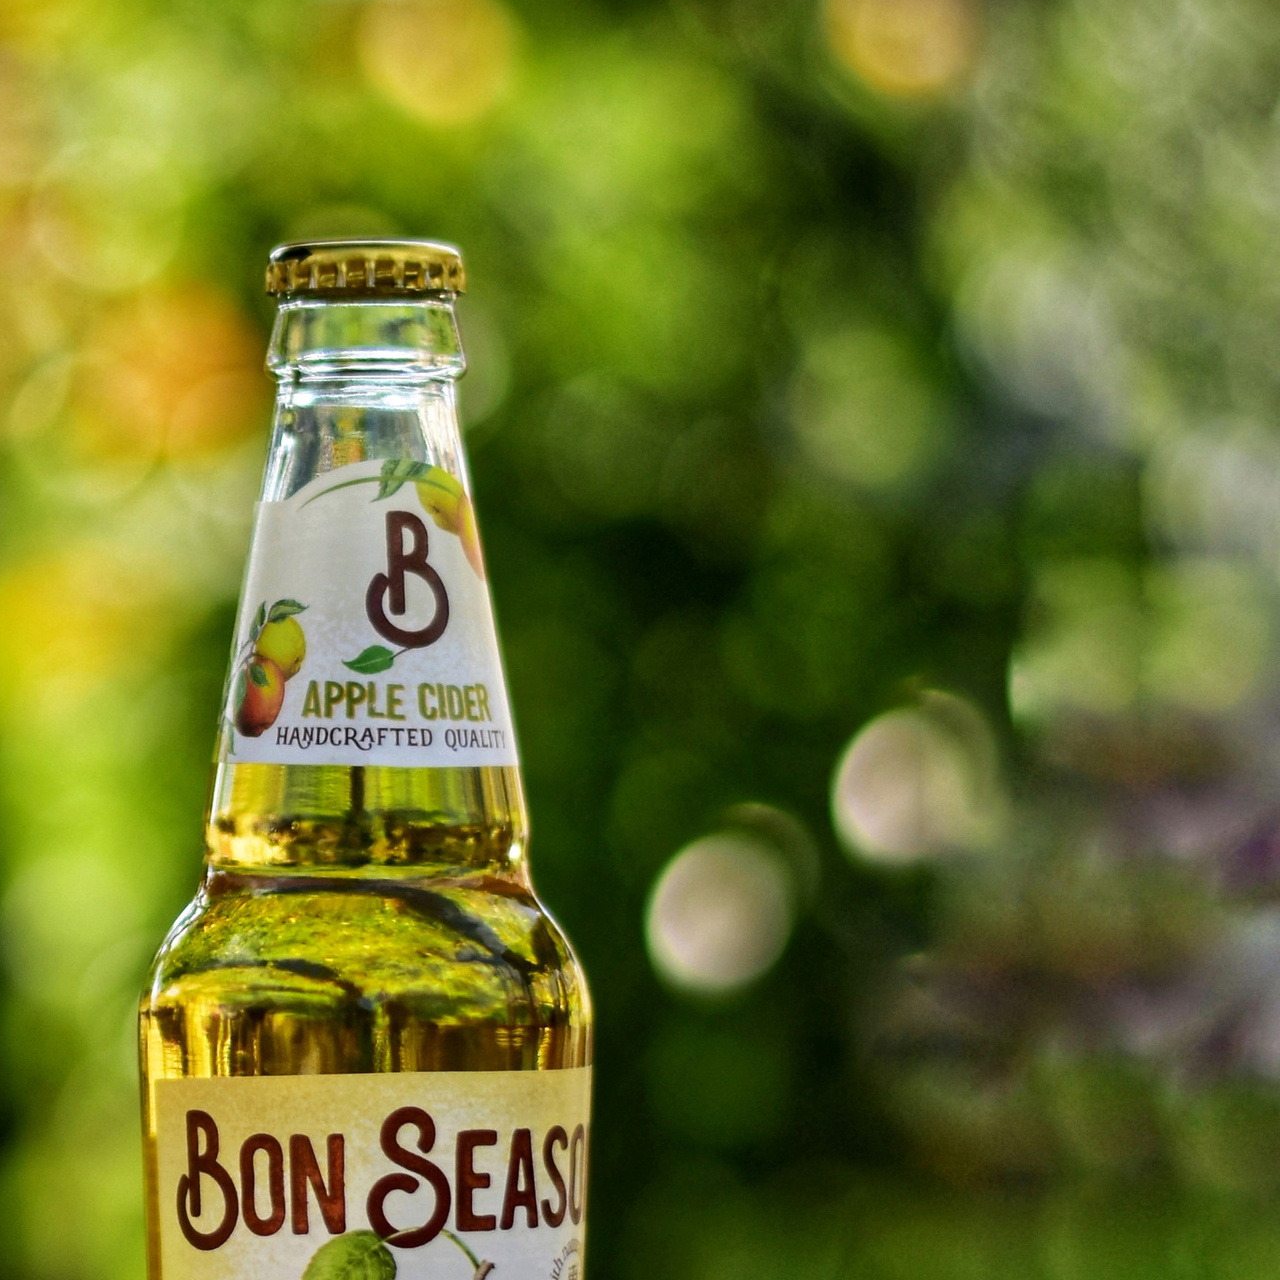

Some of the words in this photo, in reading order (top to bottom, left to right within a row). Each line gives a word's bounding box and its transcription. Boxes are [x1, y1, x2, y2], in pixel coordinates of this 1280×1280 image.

[365, 510, 449, 649] B
[275, 725, 433, 751] HANDCRAFTED
[444, 728, 506, 752] QUALITY
[300, 679, 406, 722] APPLE
[417, 682, 492, 723] CIDER
[177, 1109, 347, 1251] BON
[366, 1106, 588, 1248] SEASO
